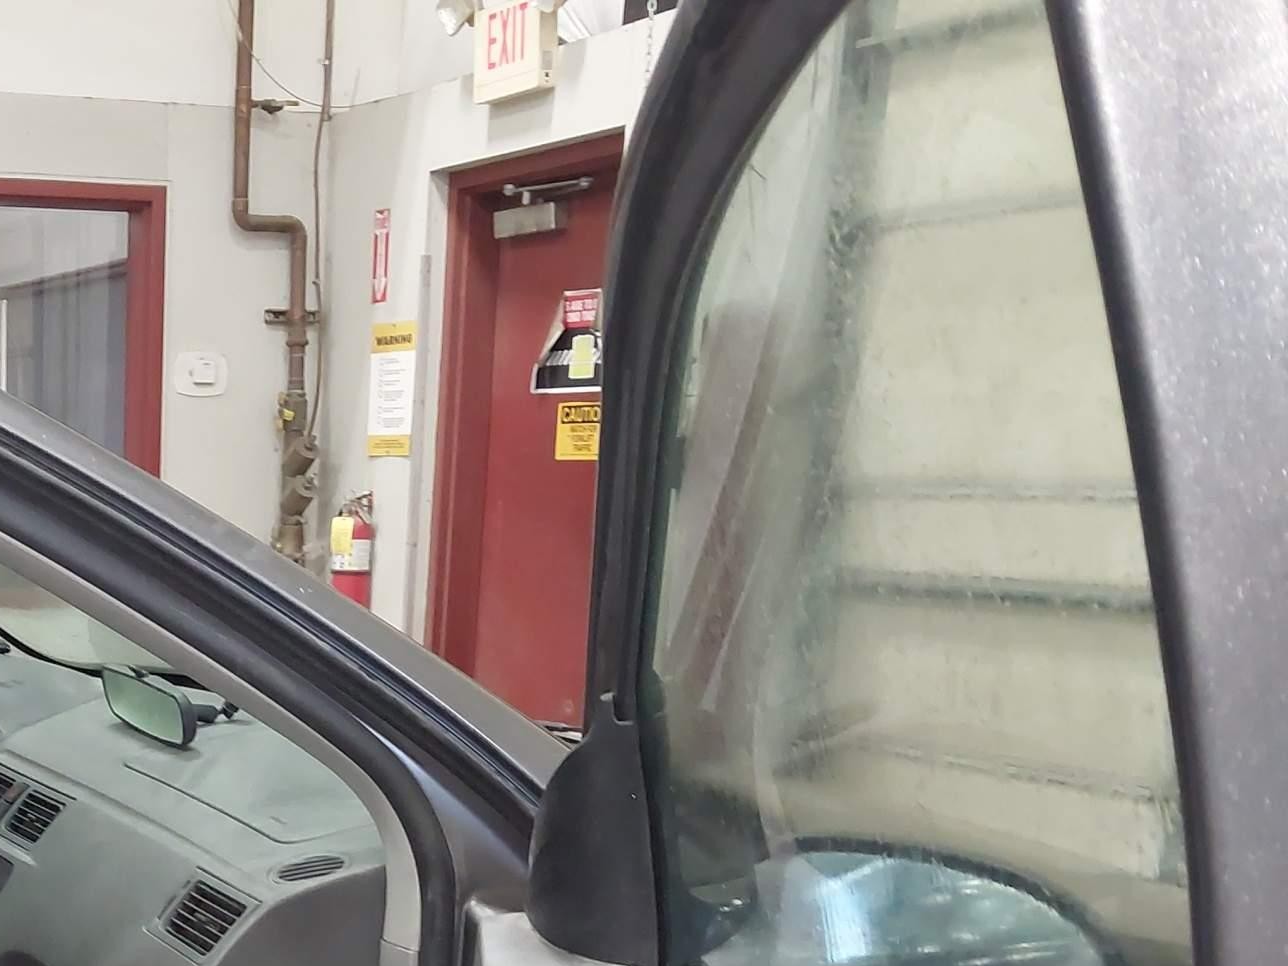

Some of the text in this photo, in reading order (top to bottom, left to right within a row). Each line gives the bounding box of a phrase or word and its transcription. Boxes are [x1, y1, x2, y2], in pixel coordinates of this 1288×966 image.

[487, 1, 529, 70] EXIT
[374, 333, 413, 346] WARNING
[562, 406, 601, 422] CAUTIO
